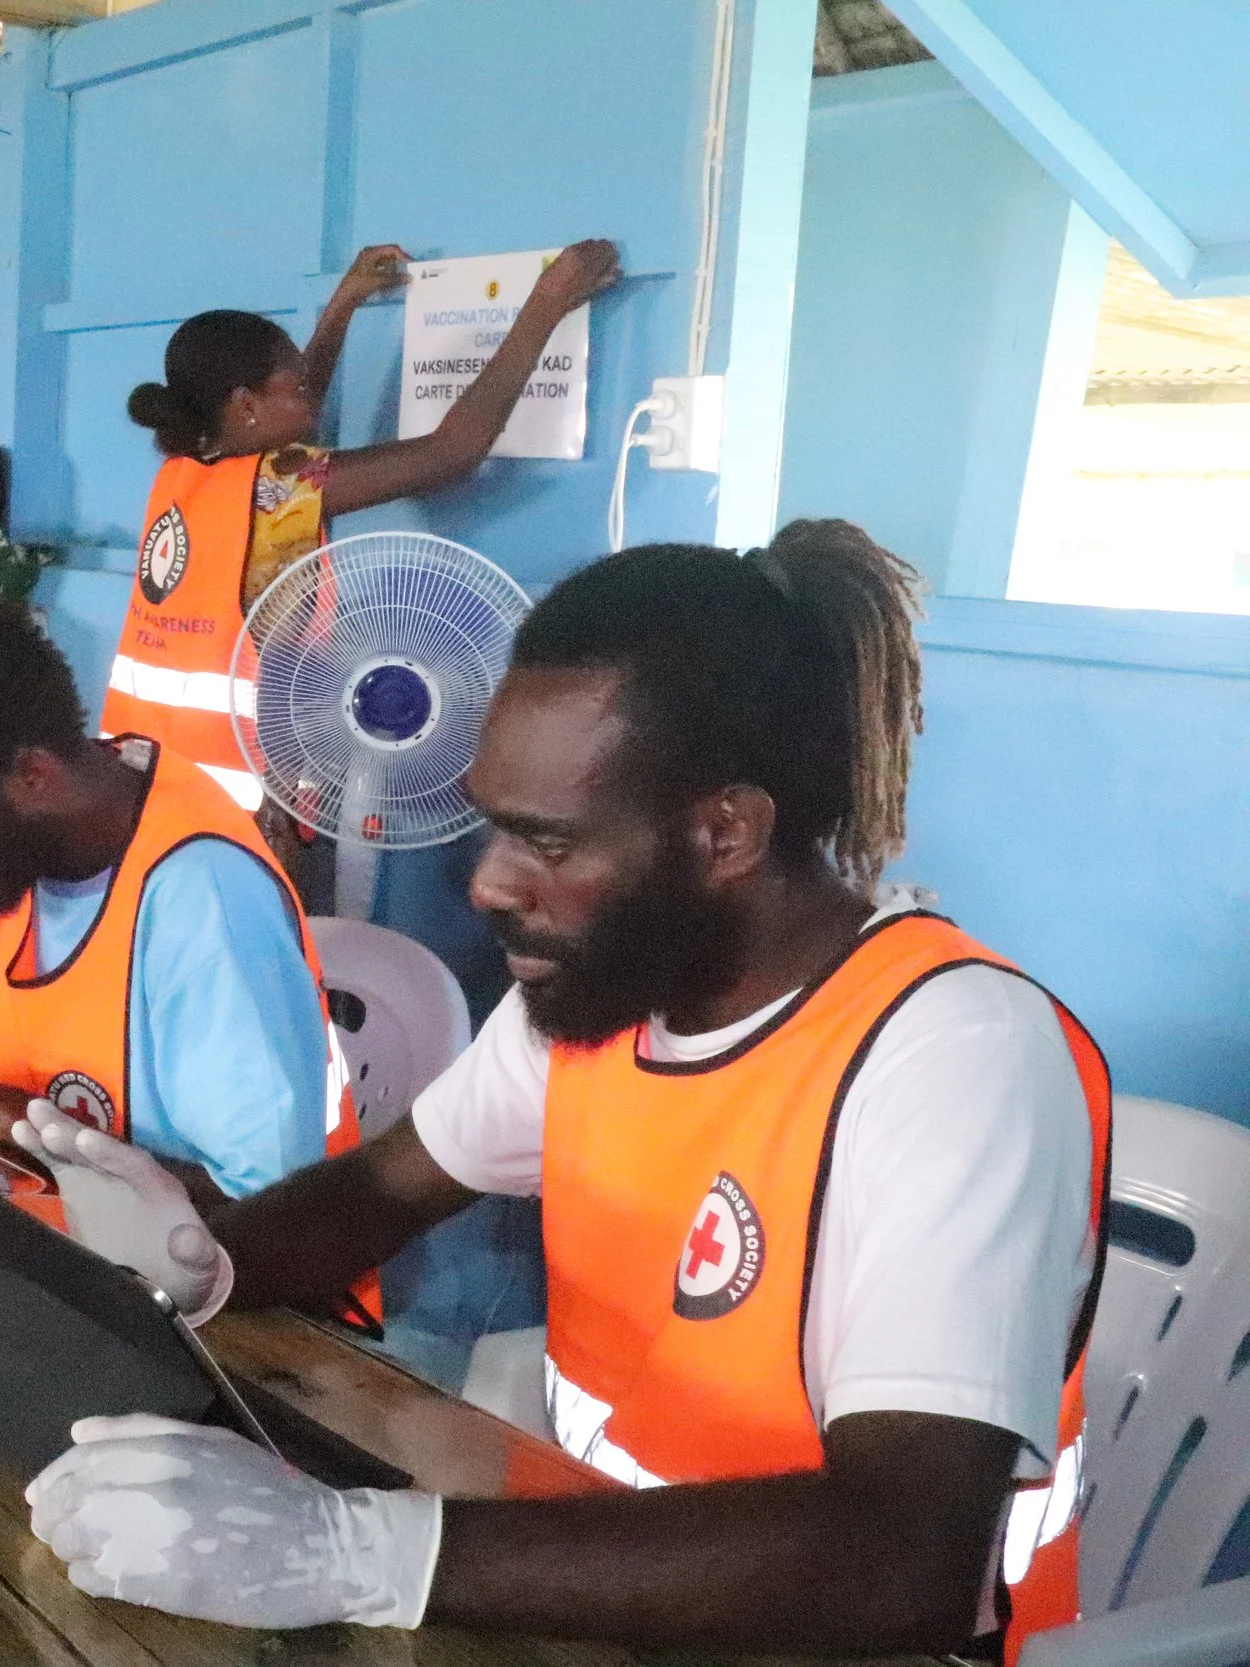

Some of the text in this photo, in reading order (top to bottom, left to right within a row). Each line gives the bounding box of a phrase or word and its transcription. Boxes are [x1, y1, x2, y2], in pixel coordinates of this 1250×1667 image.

[488, 281, 498, 298] 8
[423, 306, 508, 327] VACCINATION
[542, 355, 573, 372] KAD
[415, 384, 452, 400] CARTE
[141, 515, 170, 580] VANUATU
[166, 525, 187, 590] SOCIETY
[720, 1177, 758, 1302] CROSS SOCIETY
